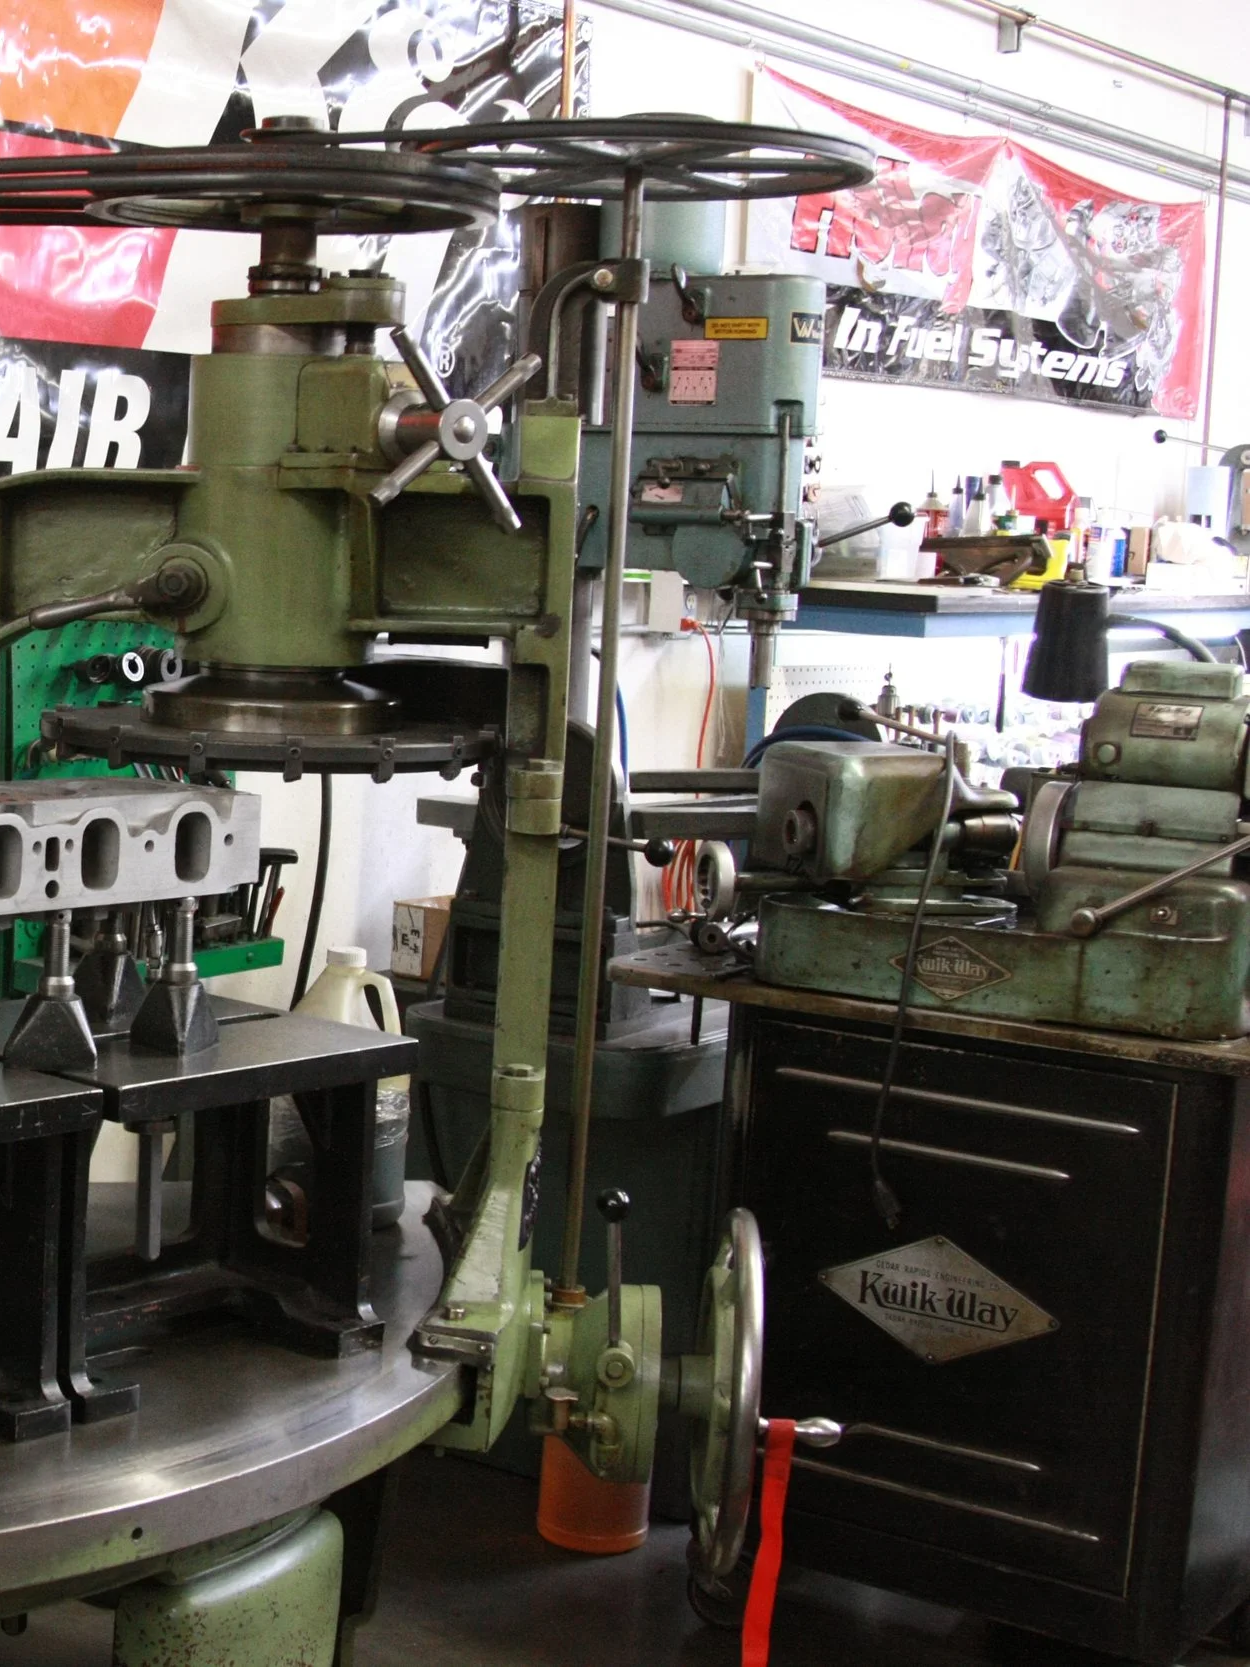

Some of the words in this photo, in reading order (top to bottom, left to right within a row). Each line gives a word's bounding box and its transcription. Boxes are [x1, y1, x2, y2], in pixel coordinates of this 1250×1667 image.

[833, 305, 882, 354] In
[886, 313, 964, 363] Fuel
[968, 327, 1128, 388] Systems
[858, 1270, 1019, 1332] Kwik-Way
